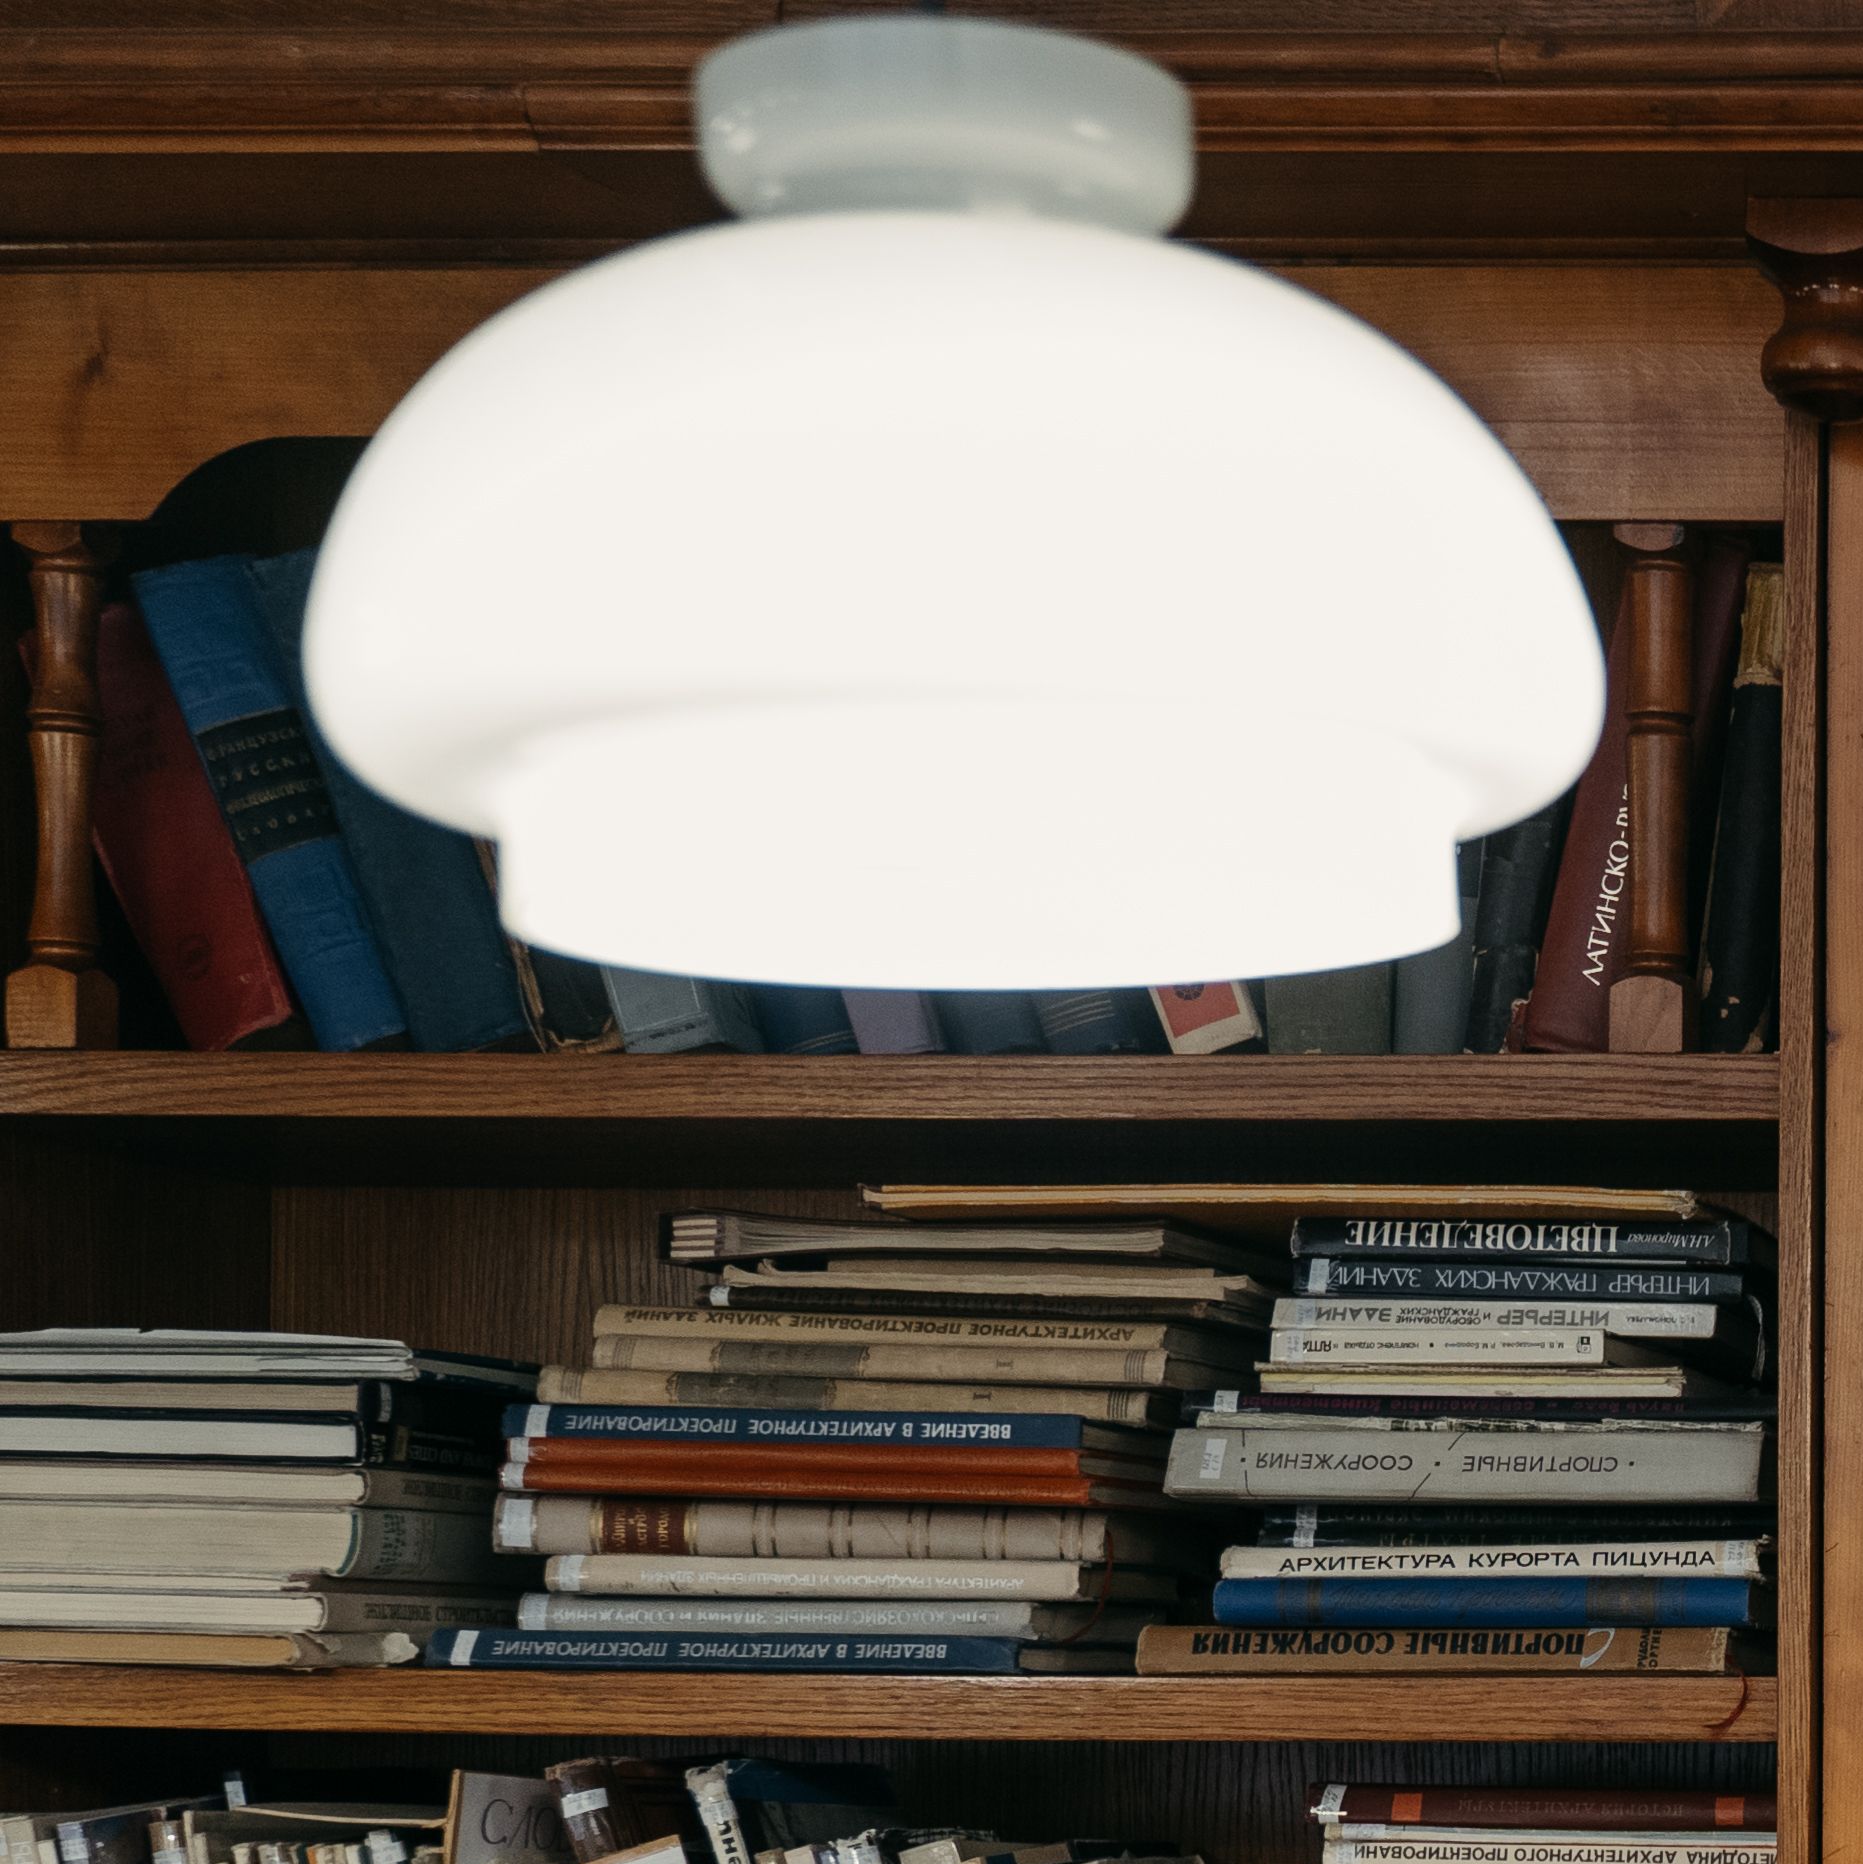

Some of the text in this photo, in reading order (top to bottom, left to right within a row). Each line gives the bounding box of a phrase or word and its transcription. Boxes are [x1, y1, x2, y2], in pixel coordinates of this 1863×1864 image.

[1344, 1216, 1619, 1251] ЦВЕТОВЕДЕНИЕ
[1435, 1268, 1709, 1295] ИНТЕРЬЕР ГРАЖДАНСКИХ
[565, 1414, 1010, 1439] ВВЕДЕНИЕ В АРХИТЕКТУРНОЕ ПРОЕКТИРОВАНИЕ
[1256, 1452, 1617, 1473] СПОРТИВНЫЕ СООРУЖЕНИЯ
[1280, 1551, 1715, 1572] АРХИТЕКТУРА КУРОРТА ПИЦУНДА
[1191, 1625, 1614, 1668] СПОРТИВНЫЕ СООРУЖЕНИЯ
